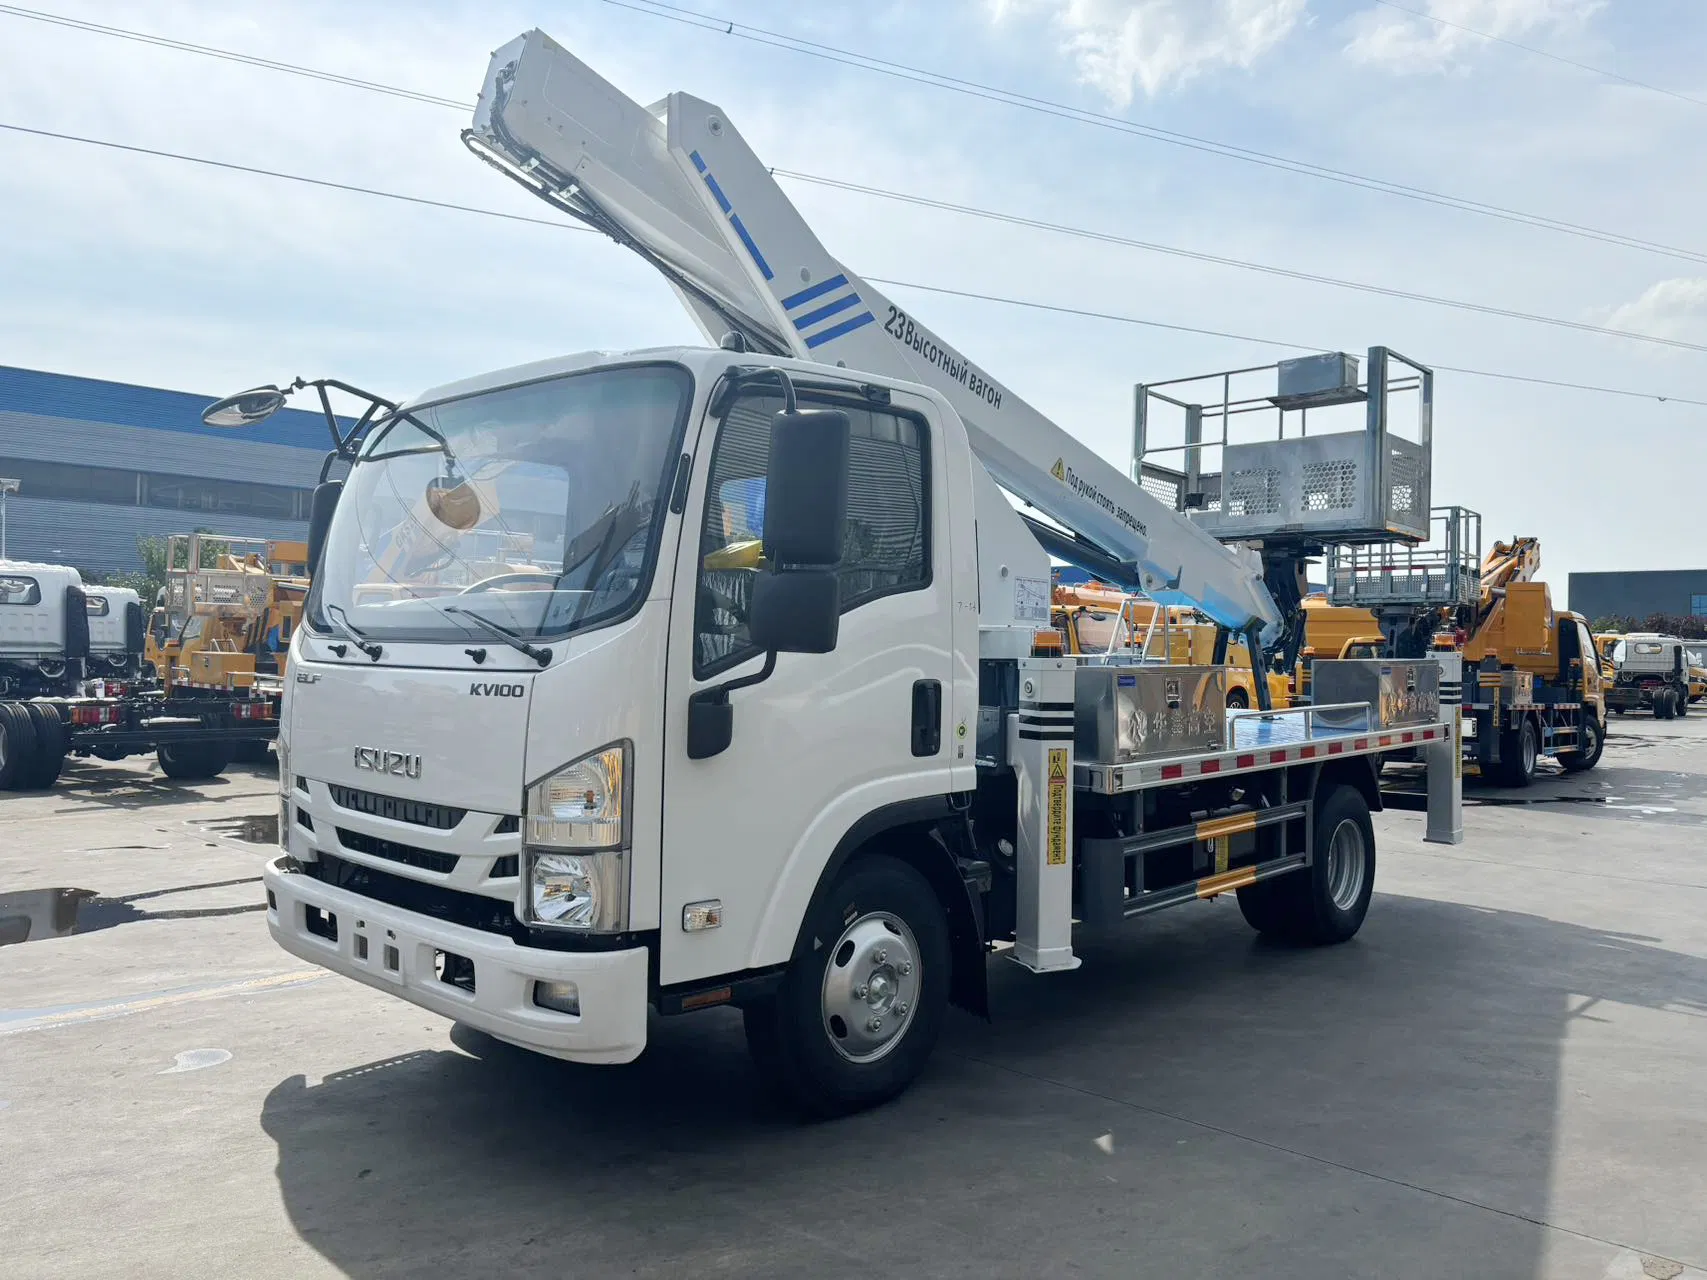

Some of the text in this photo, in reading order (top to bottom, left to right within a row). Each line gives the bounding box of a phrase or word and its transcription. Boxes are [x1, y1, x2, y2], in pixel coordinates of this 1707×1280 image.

[968, 373, 1002, 410] вагон
[470, 683, 524, 698] KV100
[354, 745, 422, 779] ISUZU
